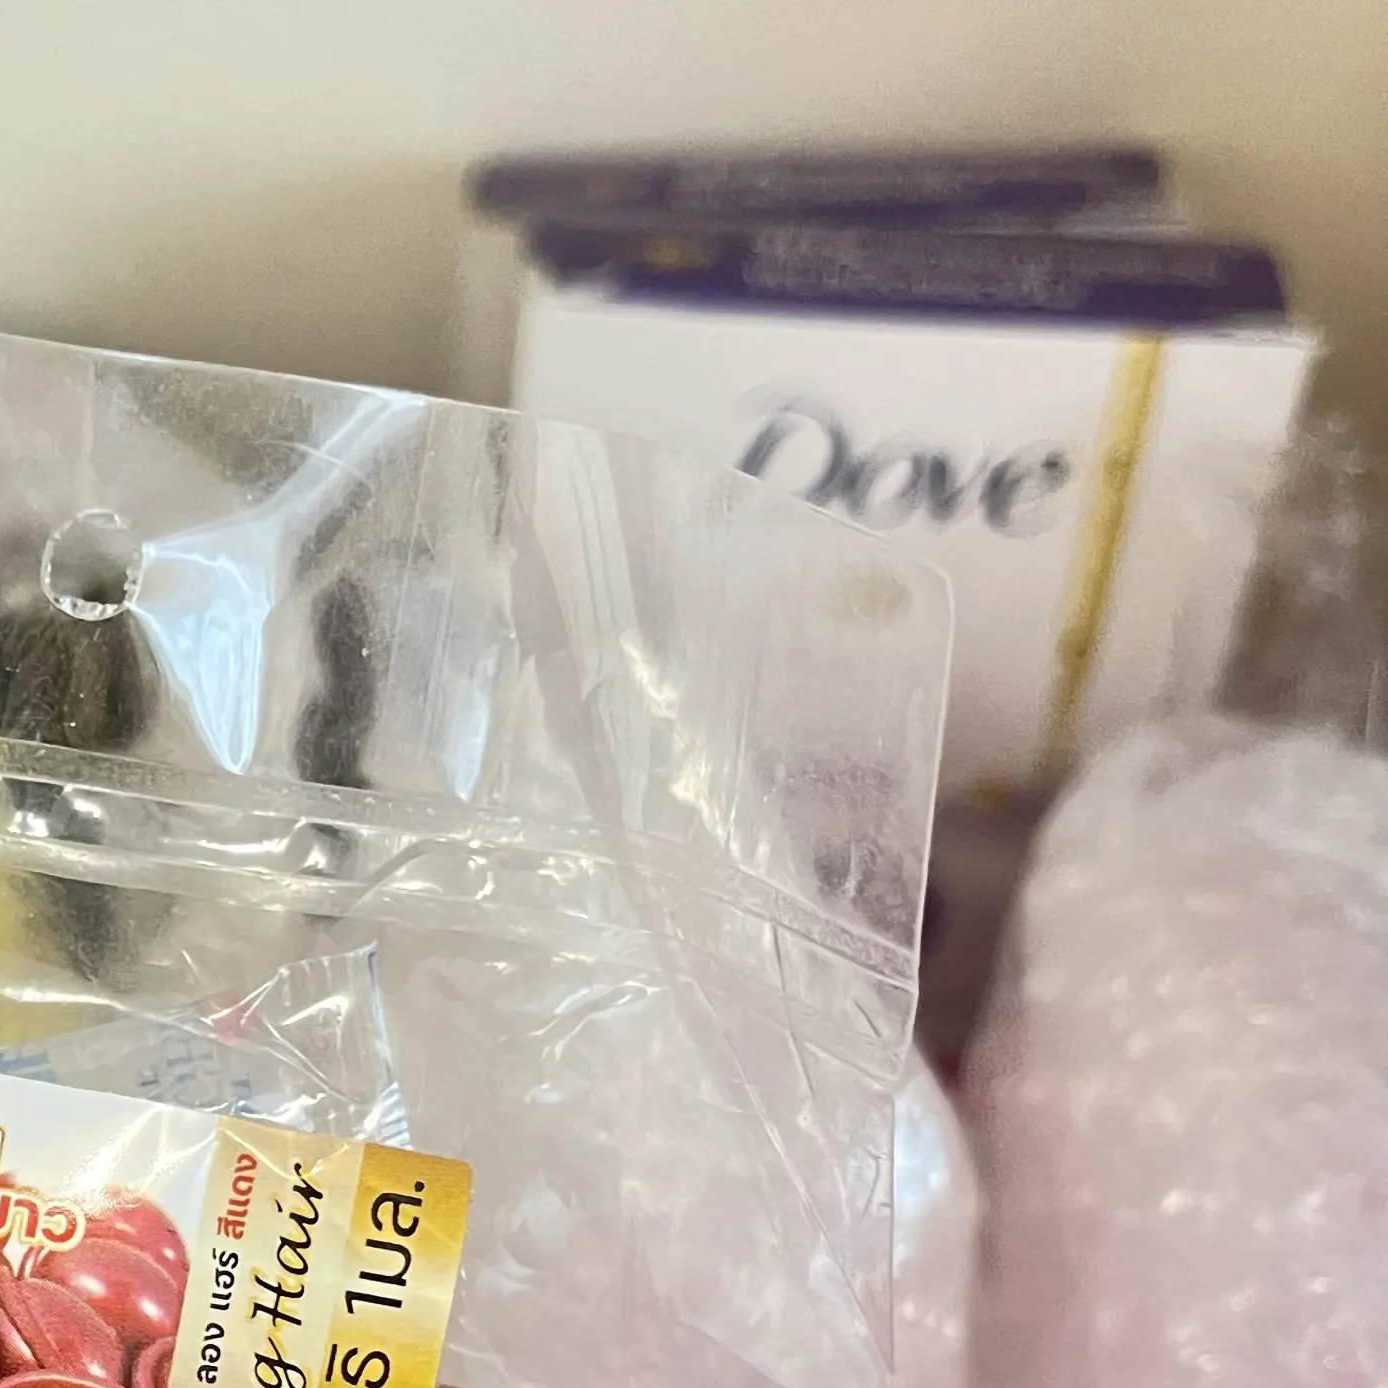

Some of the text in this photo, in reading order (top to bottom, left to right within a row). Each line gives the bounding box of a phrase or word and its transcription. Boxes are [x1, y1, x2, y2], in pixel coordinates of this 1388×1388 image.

[730, 400, 1070, 535] Dove
[216, 1153, 257, 1241] สีแดง
[252, 1162, 324, 1326] Hair
[347, 1179, 425, 1313] 1มล.
[210, 1248, 239, 1312] แฮร์
[196, 1323, 224, 1384] ลอง
